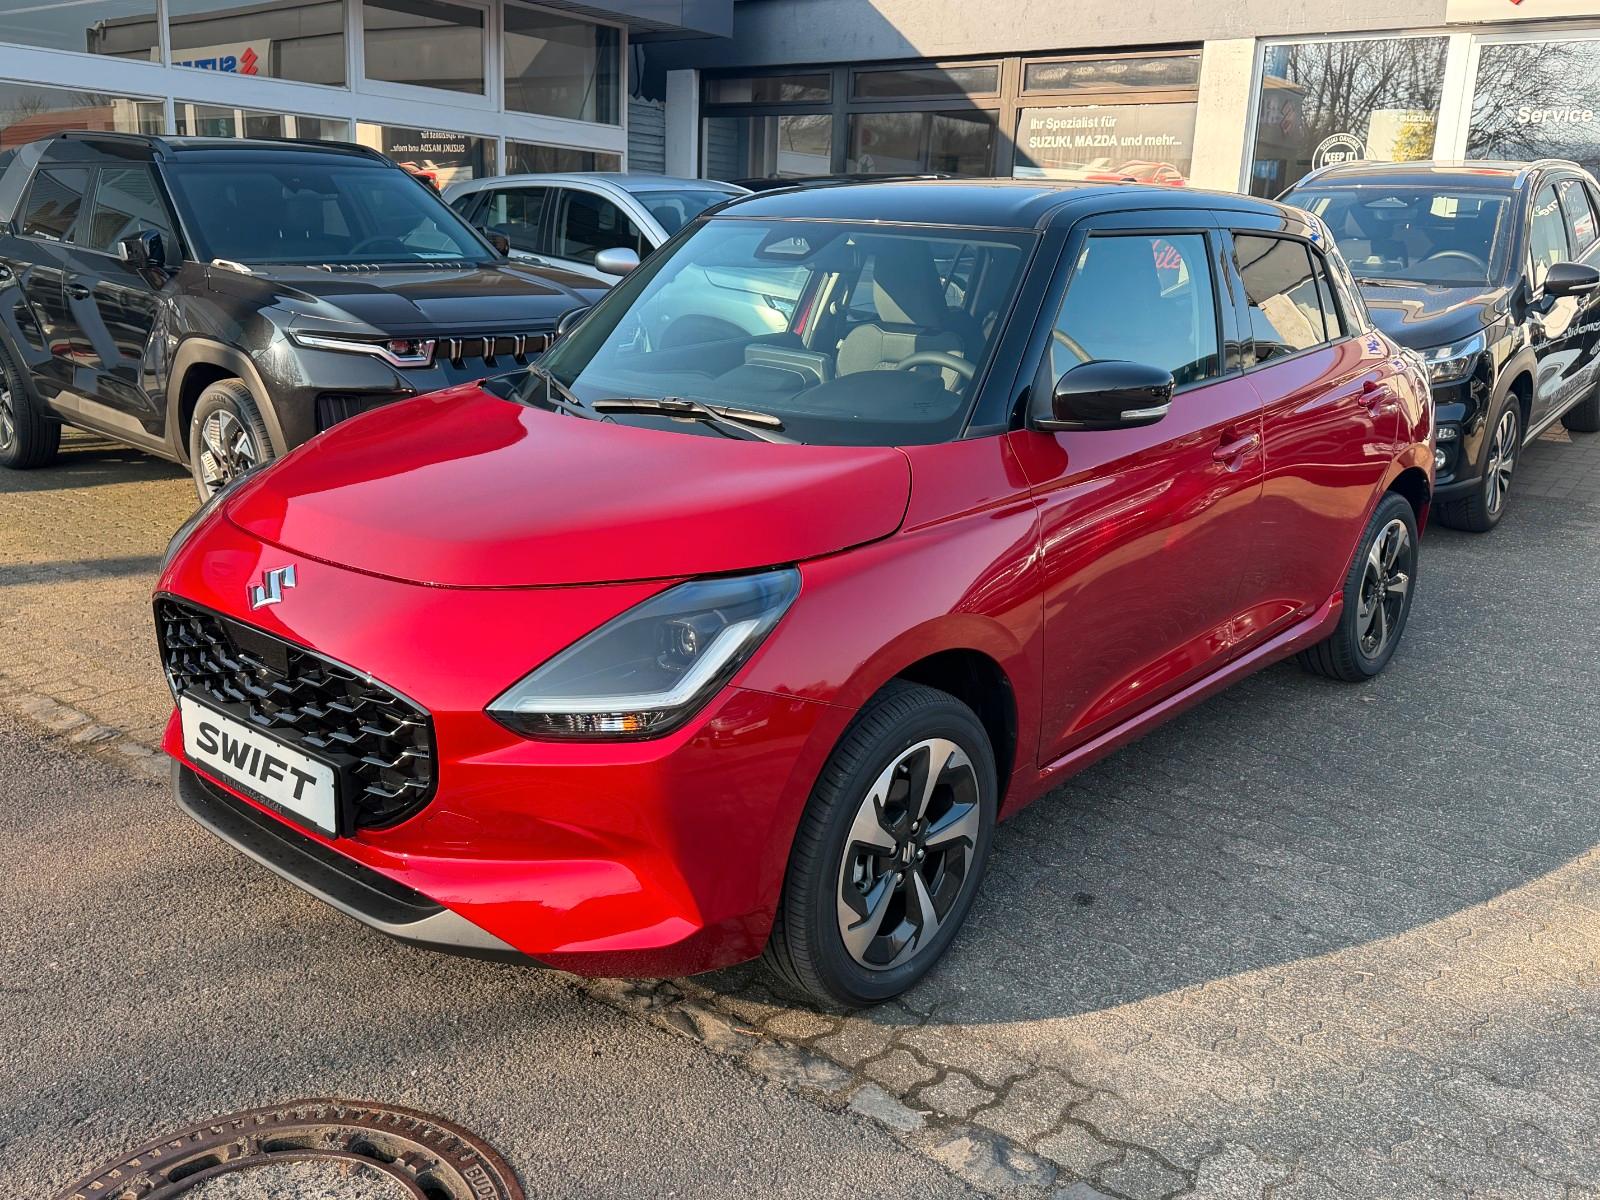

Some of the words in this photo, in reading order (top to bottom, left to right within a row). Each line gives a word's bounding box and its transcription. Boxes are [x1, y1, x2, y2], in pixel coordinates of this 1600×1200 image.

[1030, 117, 1044, 130] Ihr
[1046, 116, 1099, 131] Spezialist
[1100, 115, 1118, 128] für
[1517, 106, 1594, 124] Service
[1029, 135, 1073, 149] SUZUKI,
[1074, 135, 1118, 148] MAZDA
[1120, 134, 1143, 147] und
[1144, 133, 1182, 147] mehr...
[1324, 152, 1345, 162] KEEP
[1346, 151, 1355, 161] IT
[196, 721, 318, 801] SWIFT
